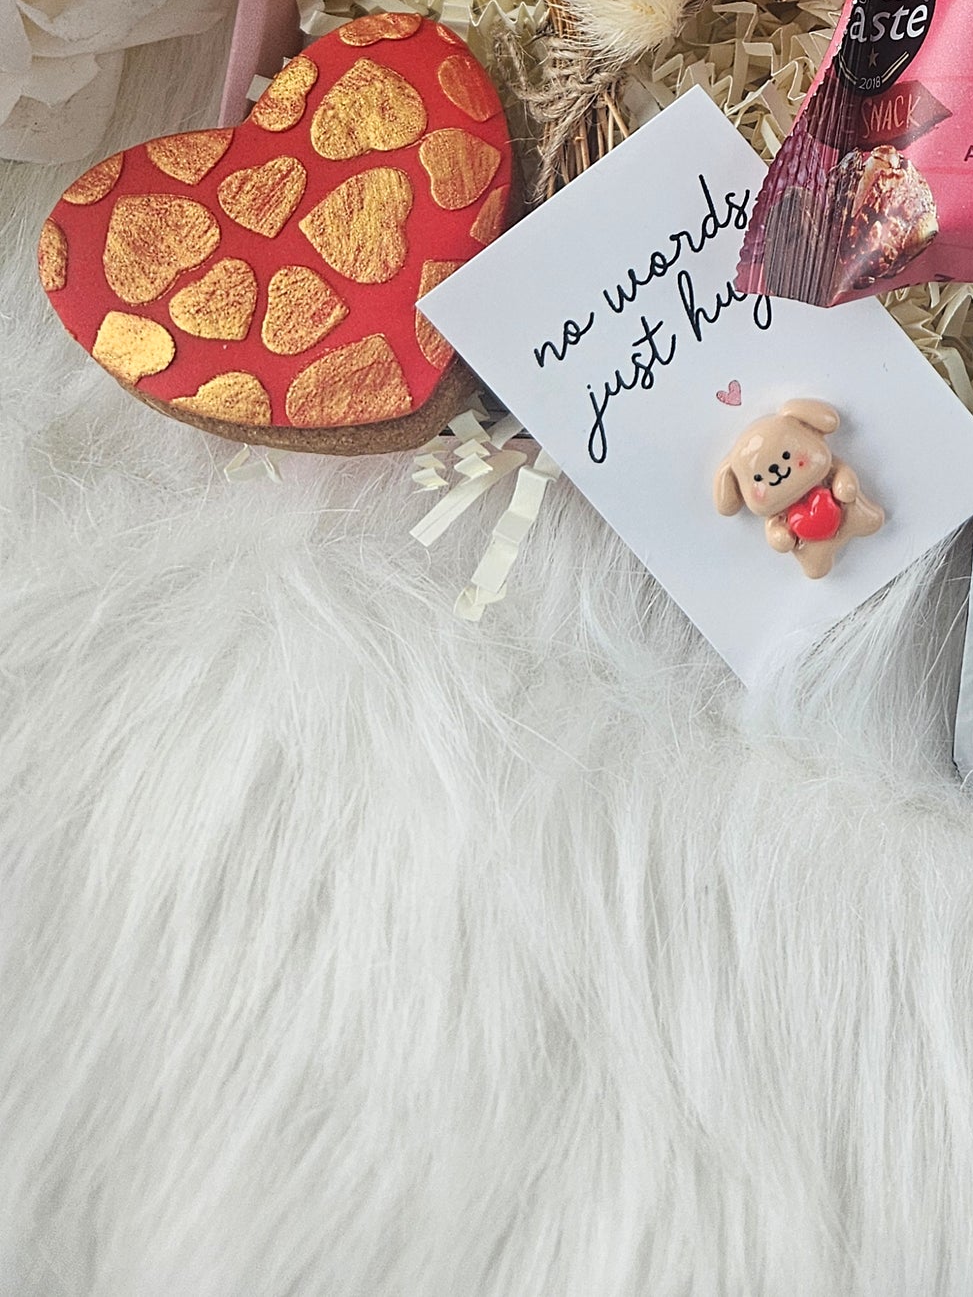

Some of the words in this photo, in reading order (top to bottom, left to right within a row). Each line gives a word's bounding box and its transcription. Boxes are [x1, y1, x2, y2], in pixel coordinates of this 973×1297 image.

[849, 4, 928, 43] aste
[858, 75, 881, 90] 2018
[861, 94, 920, 139] SNACK
[533, 310, 595, 368] no
[586, 316, 678, 464] just
